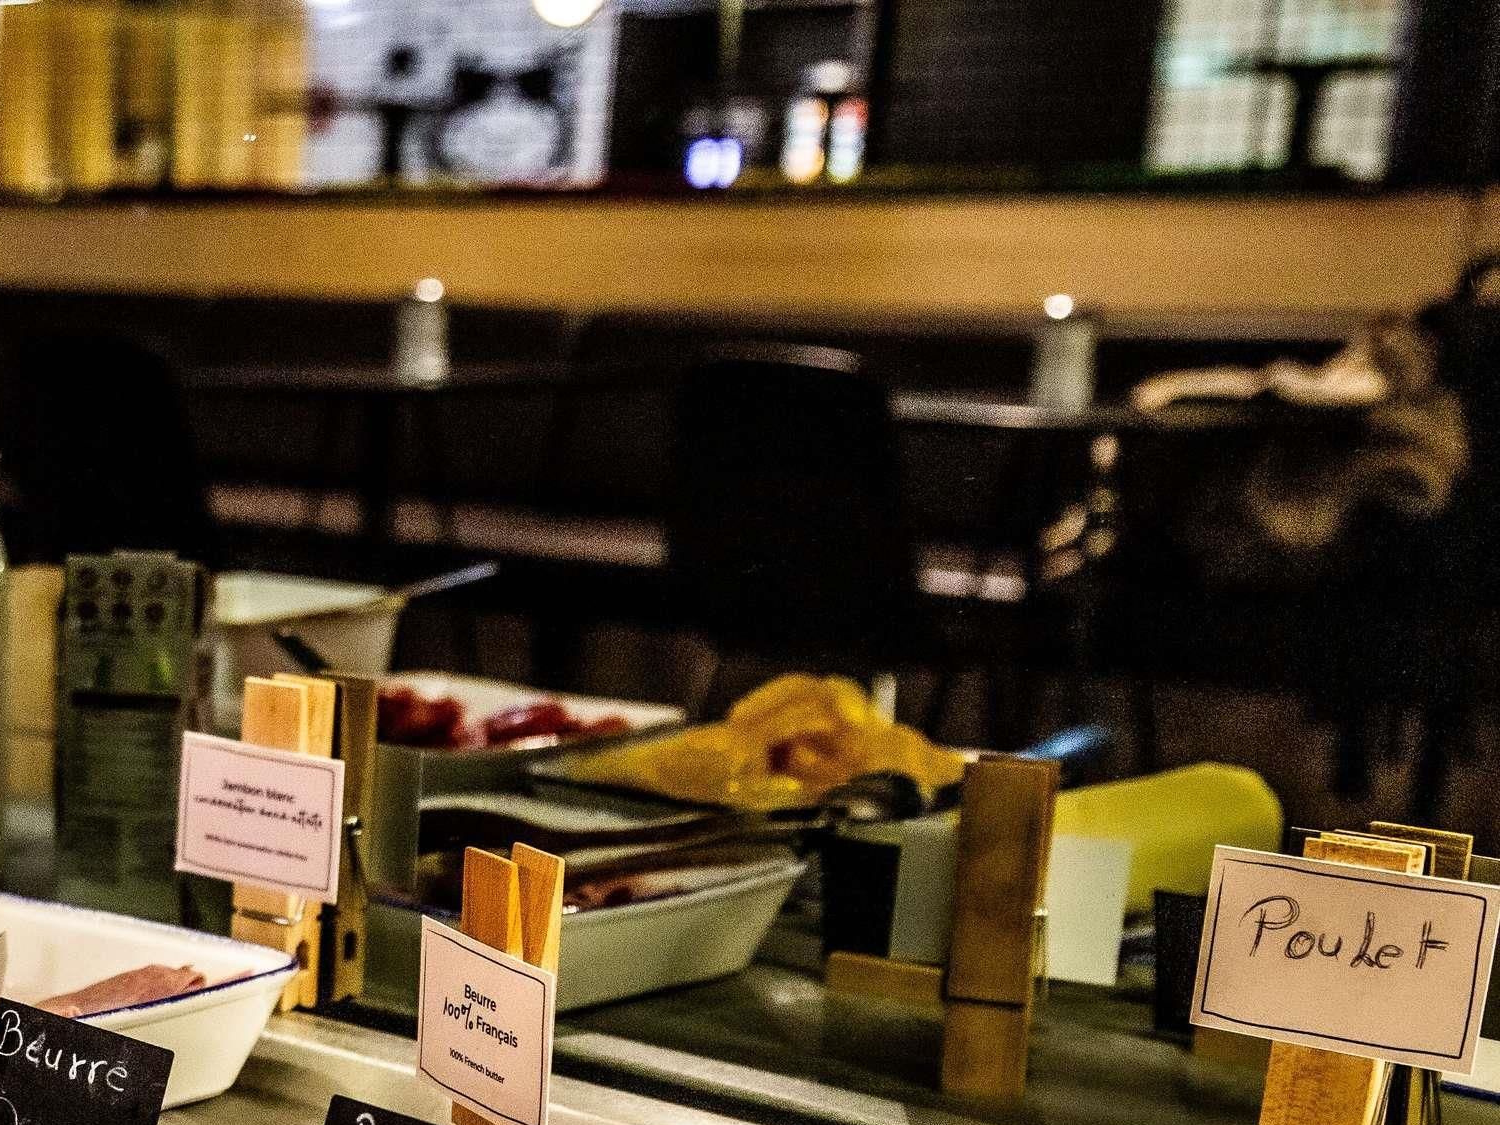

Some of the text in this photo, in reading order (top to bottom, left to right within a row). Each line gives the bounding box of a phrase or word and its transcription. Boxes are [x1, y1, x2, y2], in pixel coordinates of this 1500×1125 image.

[463, 983, 498, 1012] Beurre
[443, 996, 519, 1049] 100% Français
[449, 1047, 505, 1085] 100% French butter
